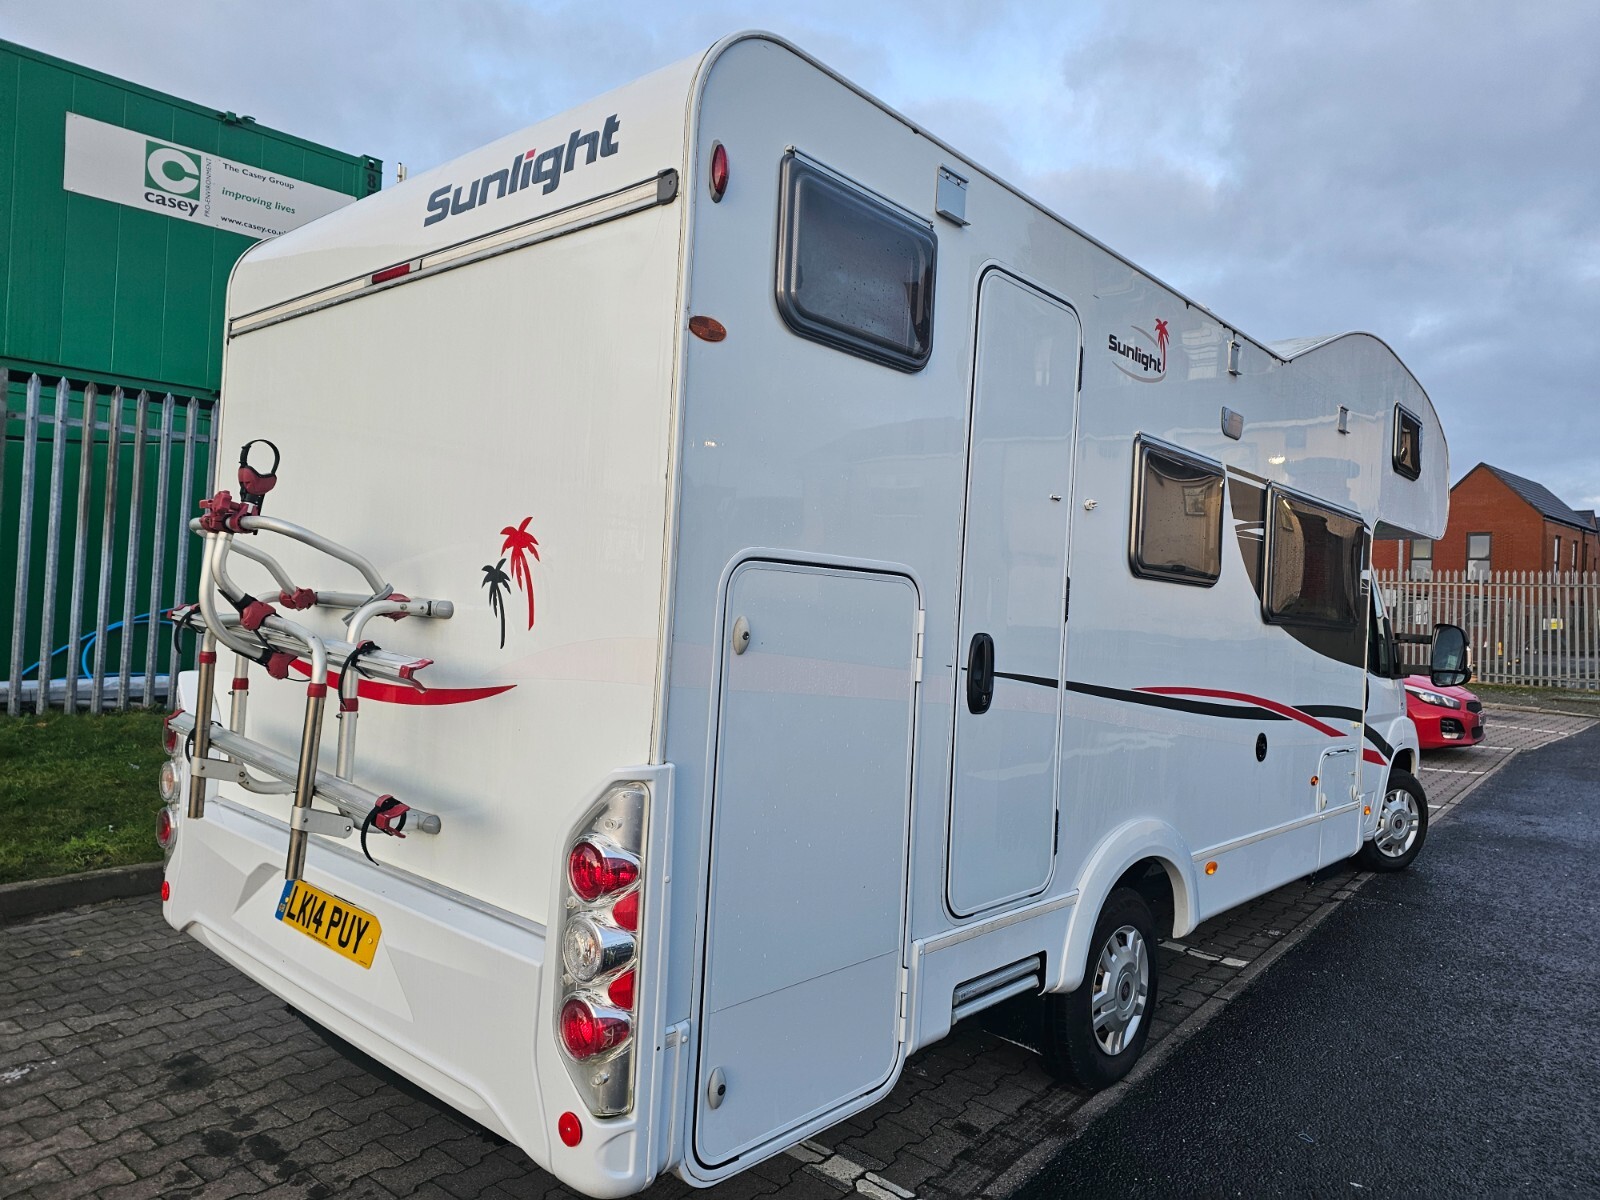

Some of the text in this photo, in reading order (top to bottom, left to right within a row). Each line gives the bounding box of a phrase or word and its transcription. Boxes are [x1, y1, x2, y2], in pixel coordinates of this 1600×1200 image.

[204, 157, 212, 218] PRO-ENVIRONMENT
[222, 162, 295, 190] The Casey Group
[423, 113, 621, 228] Sunlight
[144, 191, 200, 217] casey
[221, 187, 296, 215] improving lives
[1108, 333, 1162, 374] Sunlight
[286, 885, 370, 954] LK14 PUY
